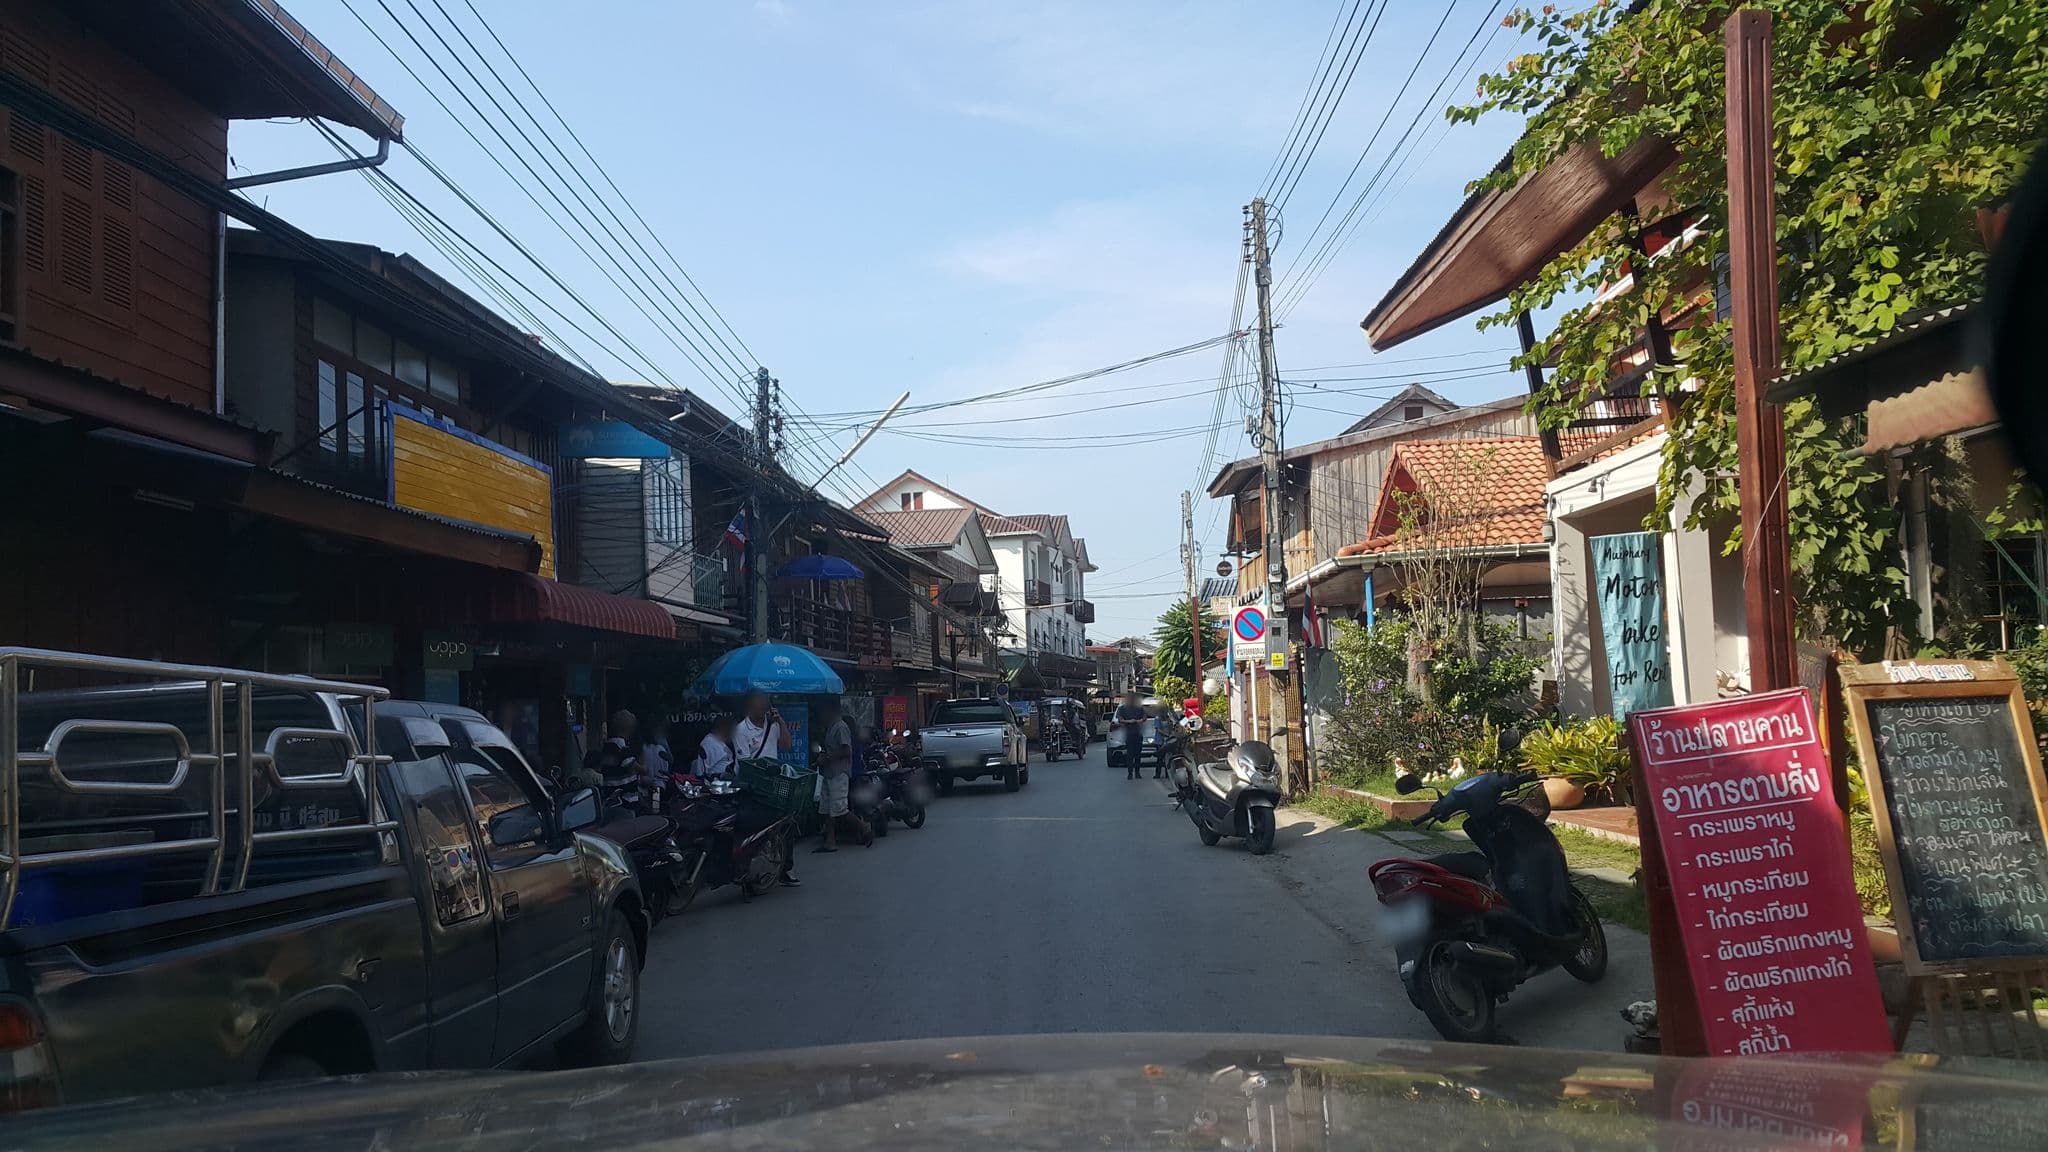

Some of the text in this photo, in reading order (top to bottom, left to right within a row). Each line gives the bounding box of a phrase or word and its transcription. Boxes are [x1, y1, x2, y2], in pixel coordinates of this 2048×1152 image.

[1605, 573, 1660, 602] Motor
[1623, 619, 1660, 646] bike
[1613, 660, 1669, 691] for Rent
[1651, 712, 1804, 755] ร้านปลายคาน
[1663, 750, 1820, 812] อาหารตามสั่ง
[1689, 811, 1795, 839] กระเพราหมู
[1696, 836, 1795, 868] กระเพราไก่
[1702, 868, 1810, 902] หมูกระเทียม
[1707, 900, 1809, 930] ไก่กระเทียม
[1718, 928, 1853, 961] ผัดพริกแกงหมู
[1724, 953, 1852, 992] ผัดพริกแกงไก่
[1731, 995, 1795, 1028] สุกี้แห้ง
[1738, 1024, 1791, 1056] สกี้น้ำ
